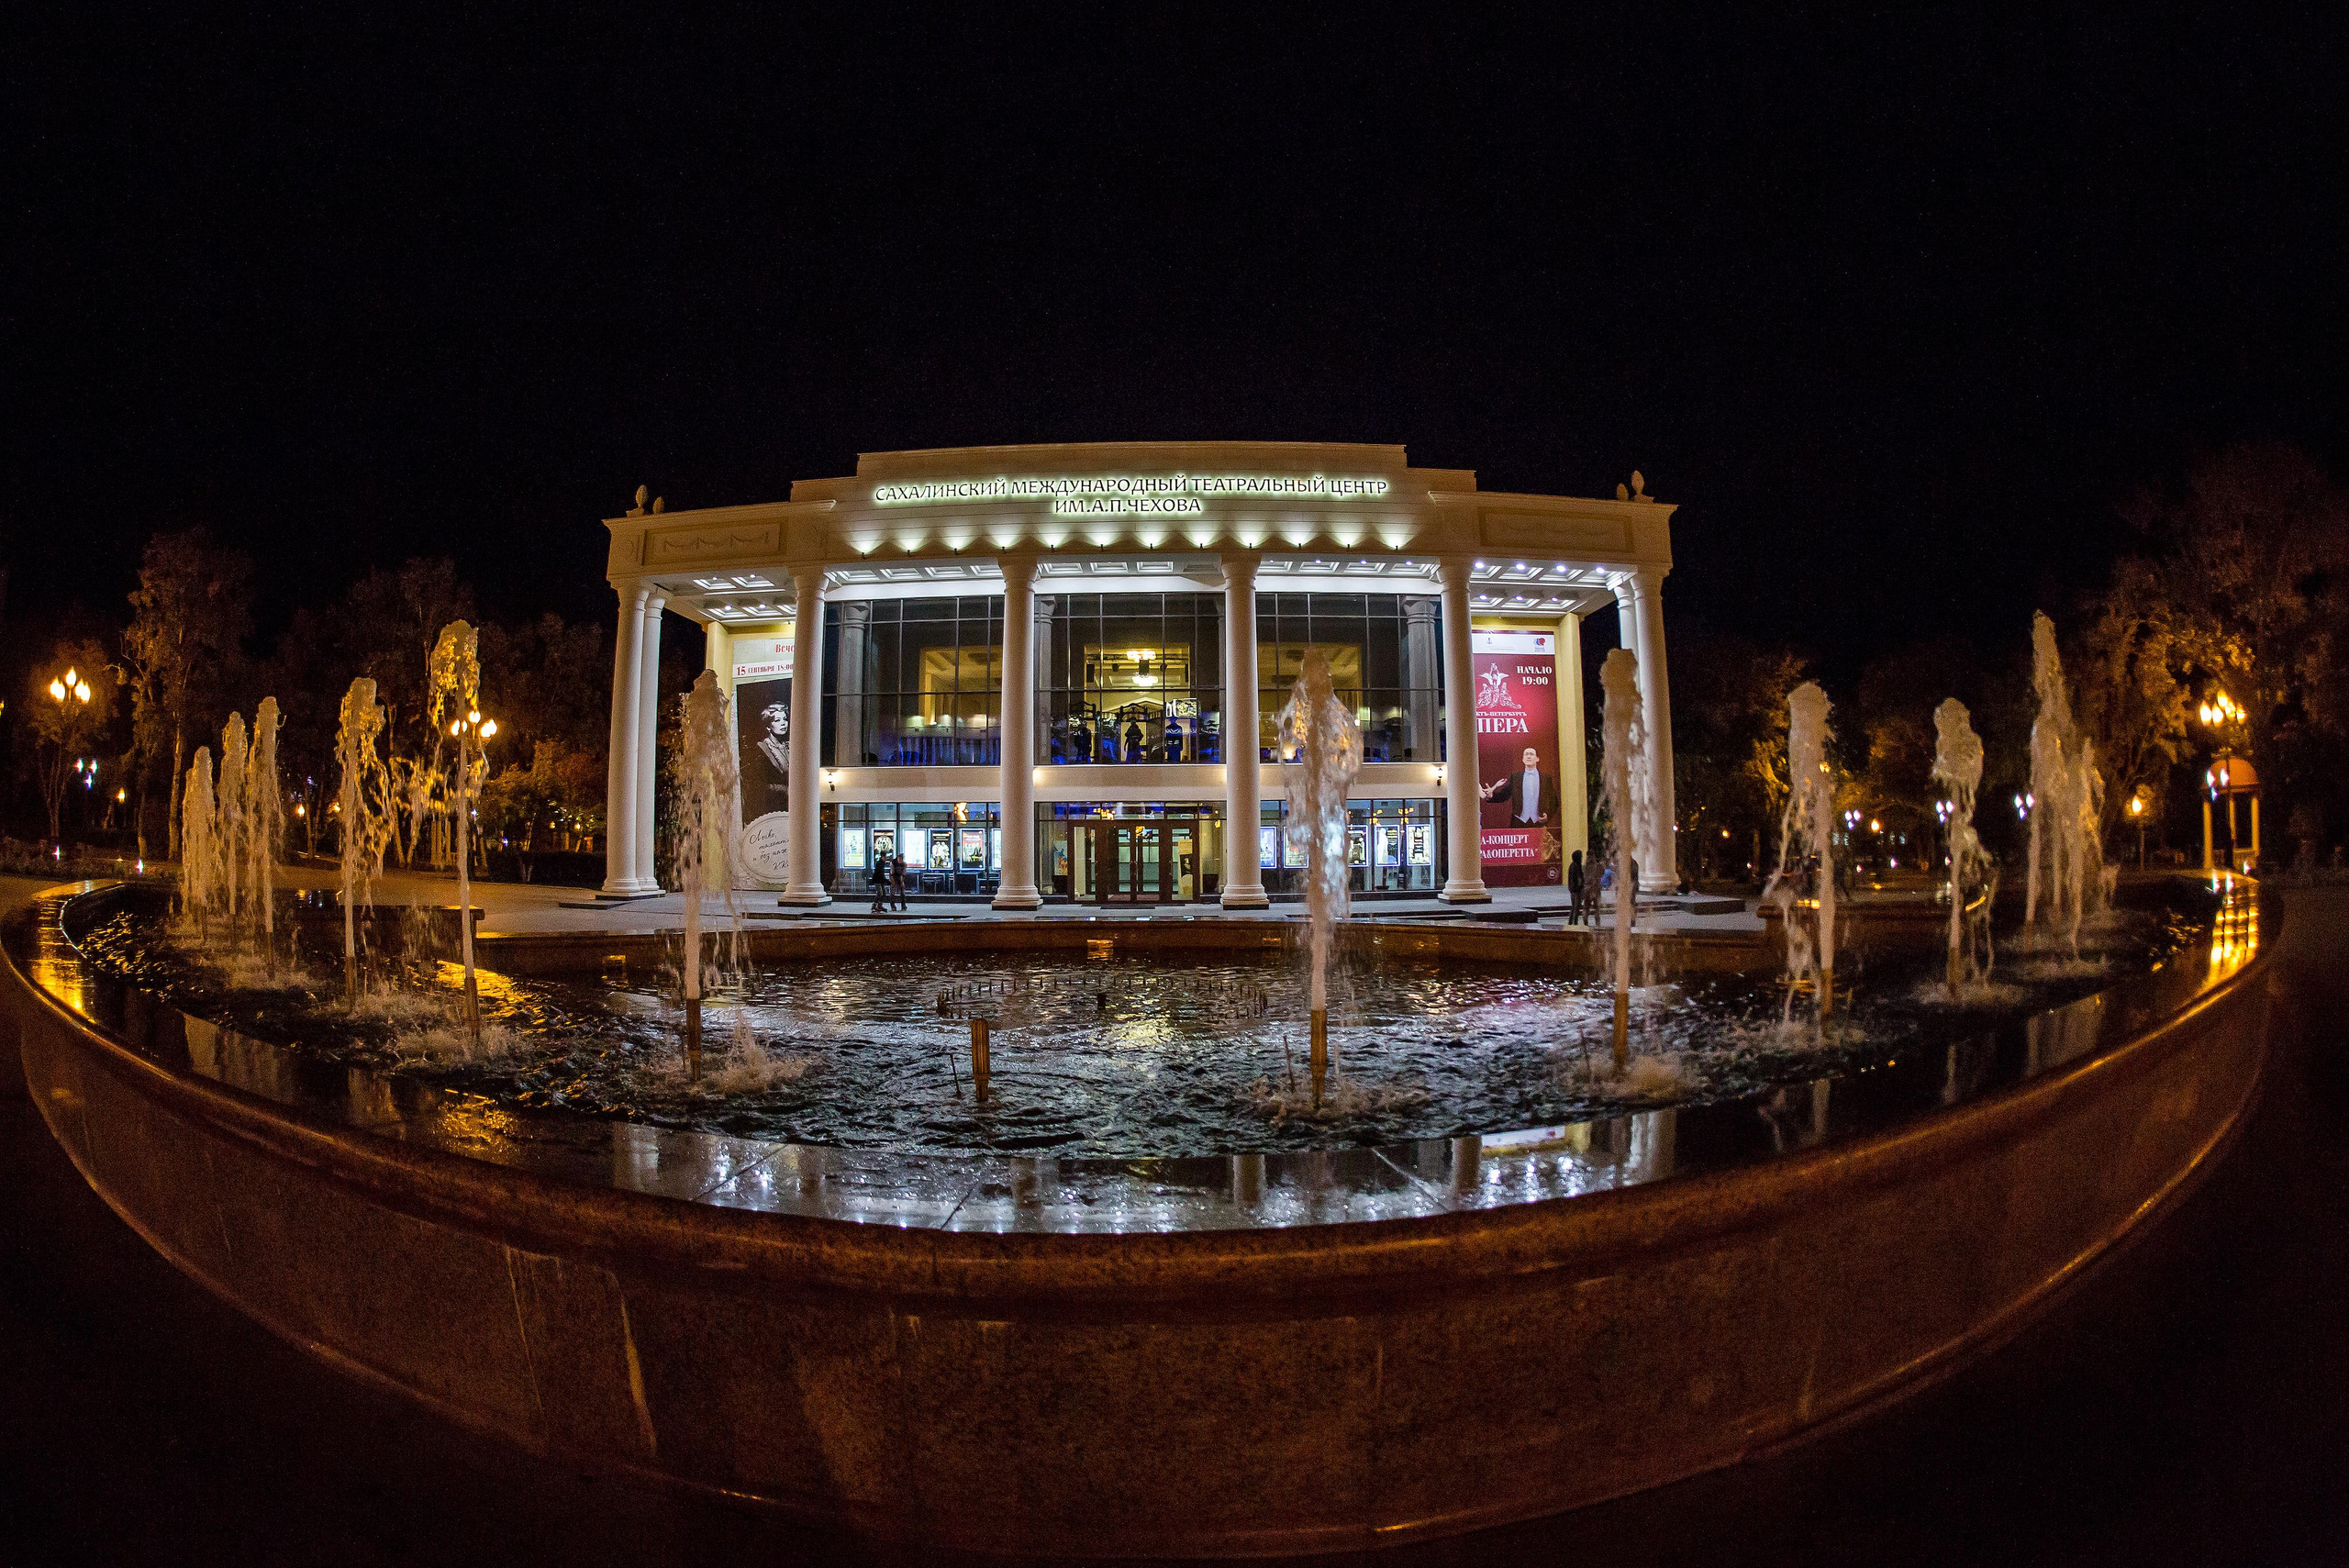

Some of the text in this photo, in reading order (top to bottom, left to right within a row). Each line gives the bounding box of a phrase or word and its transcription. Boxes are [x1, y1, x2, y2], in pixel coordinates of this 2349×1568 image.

[875, 475, 1387, 501] САХАЛИНСКИЙ МЕЖДУНАРОДНЫЙ ТЕАТРАЛЬНЫЙ ЦЕНТР
[1055, 498, 1202, 513] ИМ.А.П.ЧЕХОВА
[737, 666, 746, 675] 15
[1517, 665, 1553, 674] НАЧАЛО
[1522, 676, 1549, 685] 19:00
